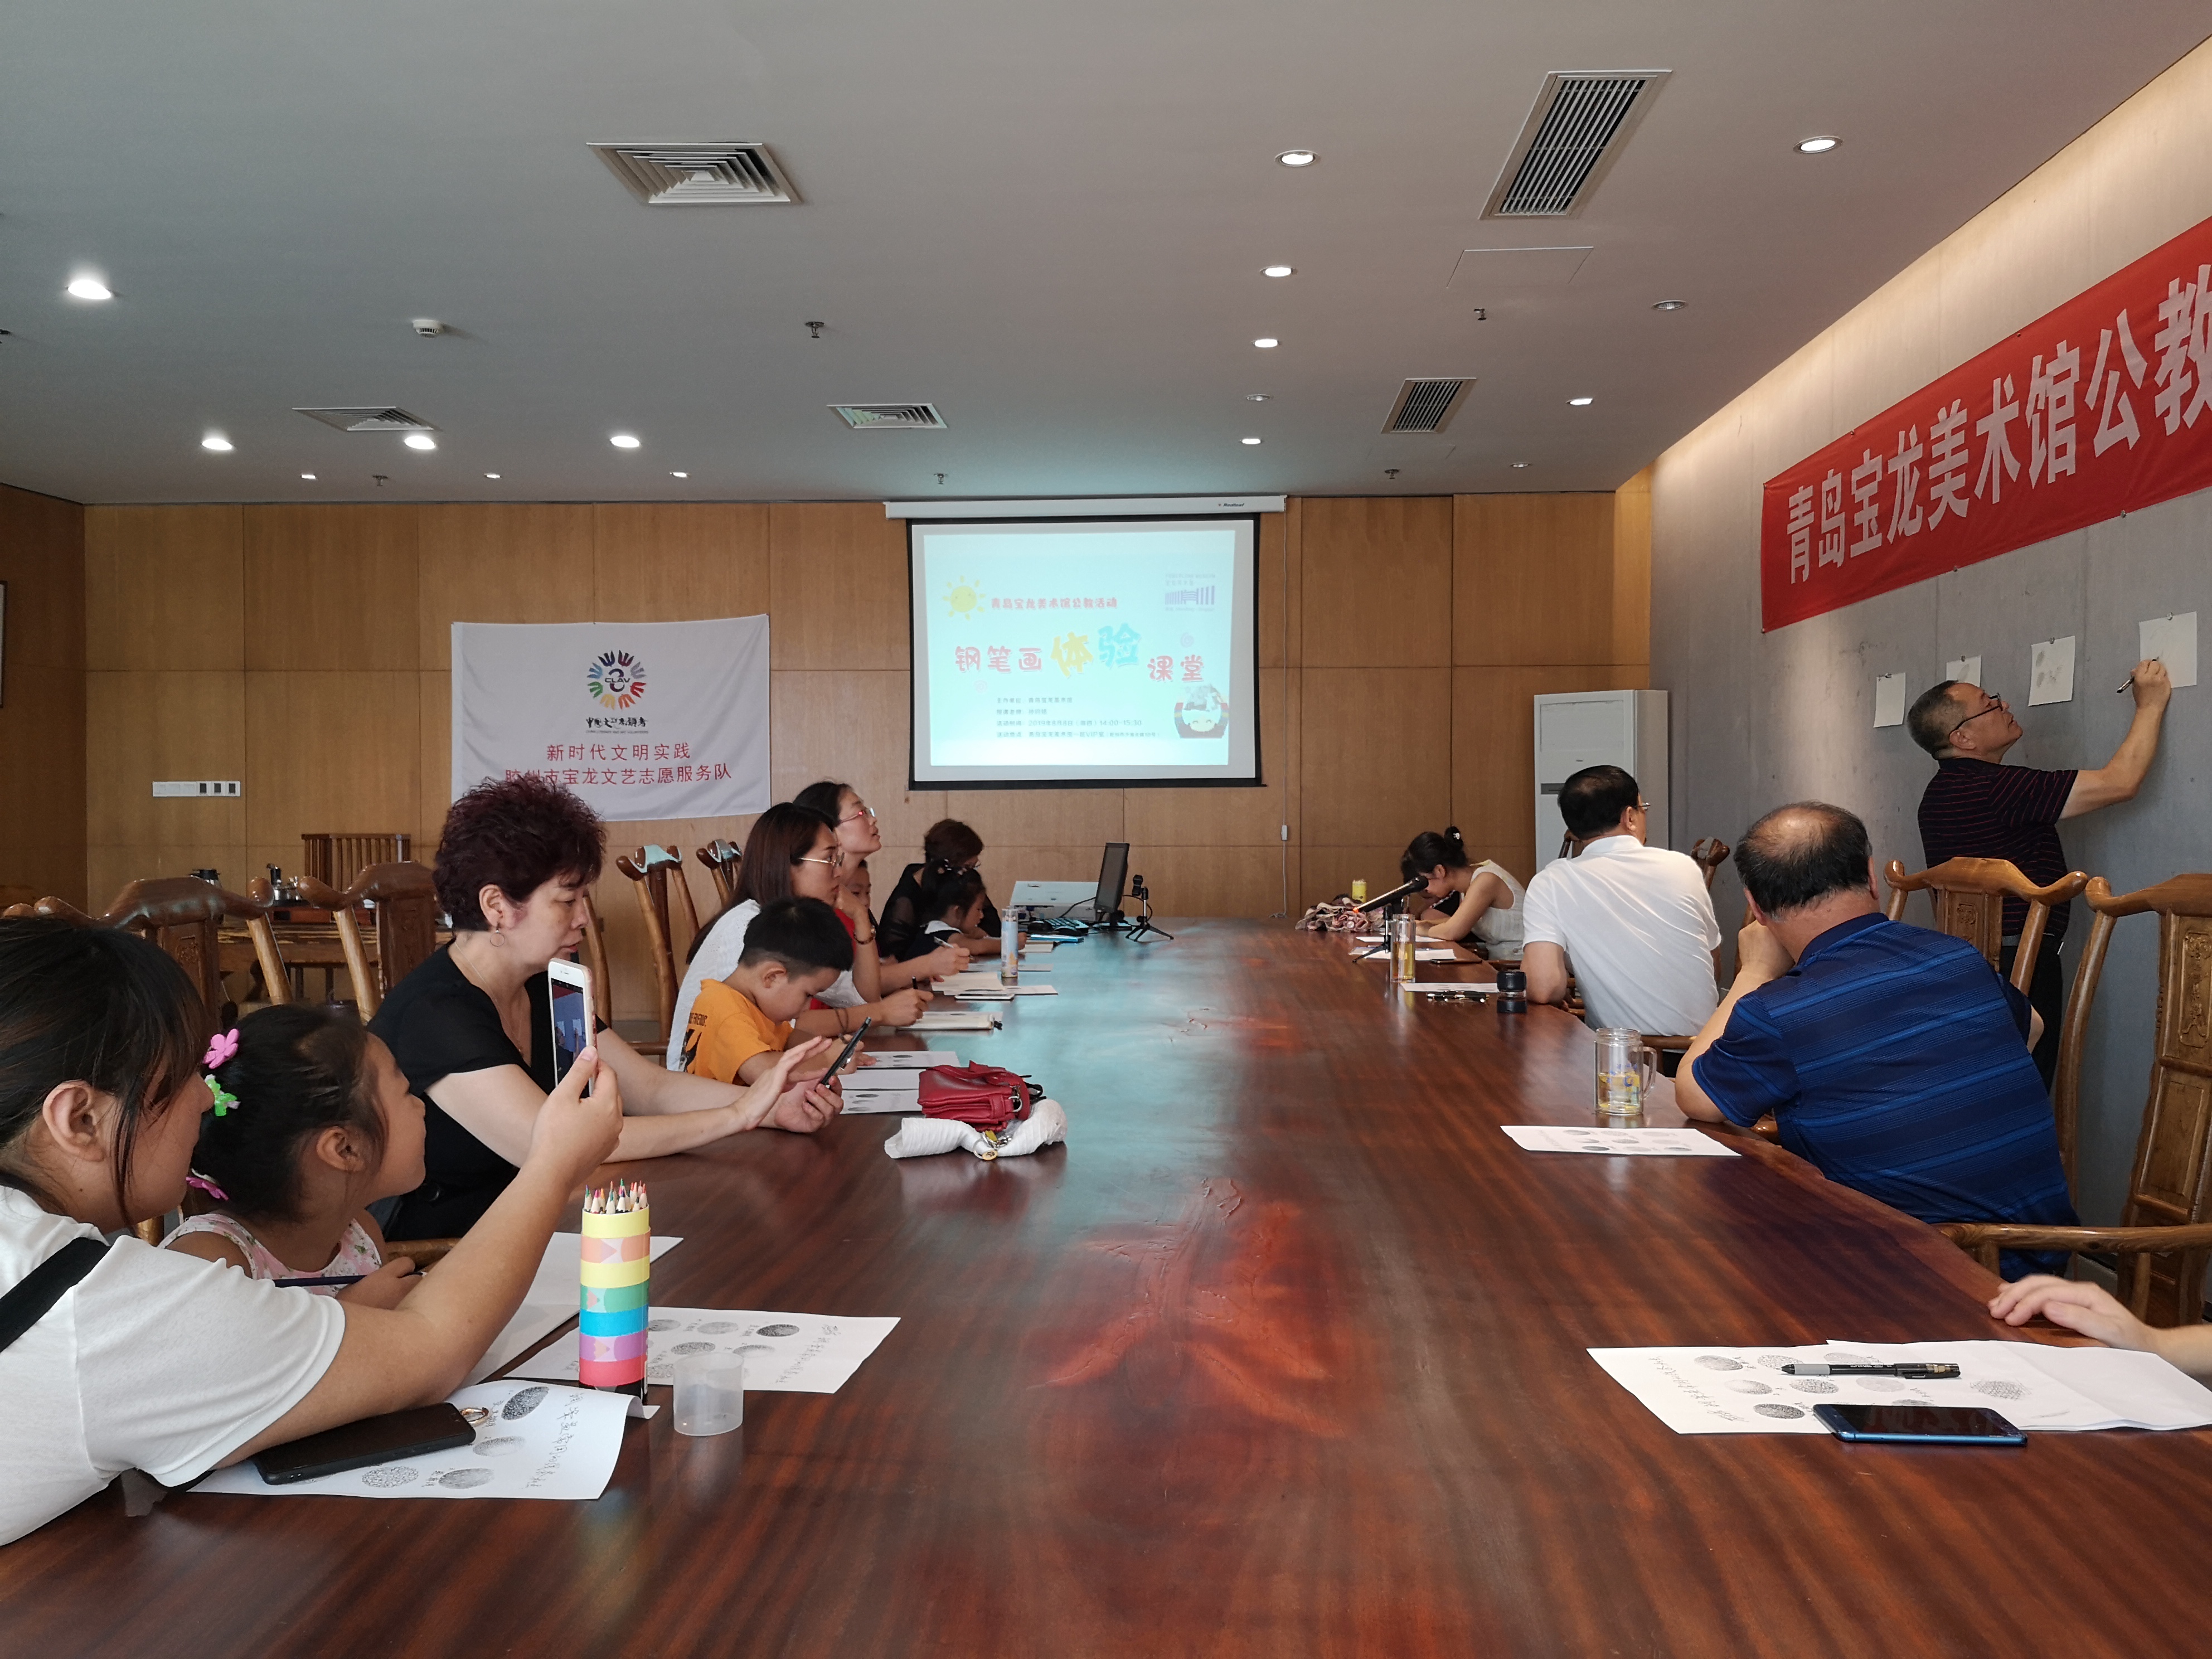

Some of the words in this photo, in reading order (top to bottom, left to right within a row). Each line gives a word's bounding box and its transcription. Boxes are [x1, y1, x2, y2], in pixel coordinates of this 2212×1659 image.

[1786, 264, 2212, 584] 青岛宝龙美术馆公教
[991, 596, 1118, 609] 青岛宝龙美术馆公教活动
[955, 623, 1204, 682] 钢笔画体验课堂
[546, 743, 691, 761] 新时代文明实践
